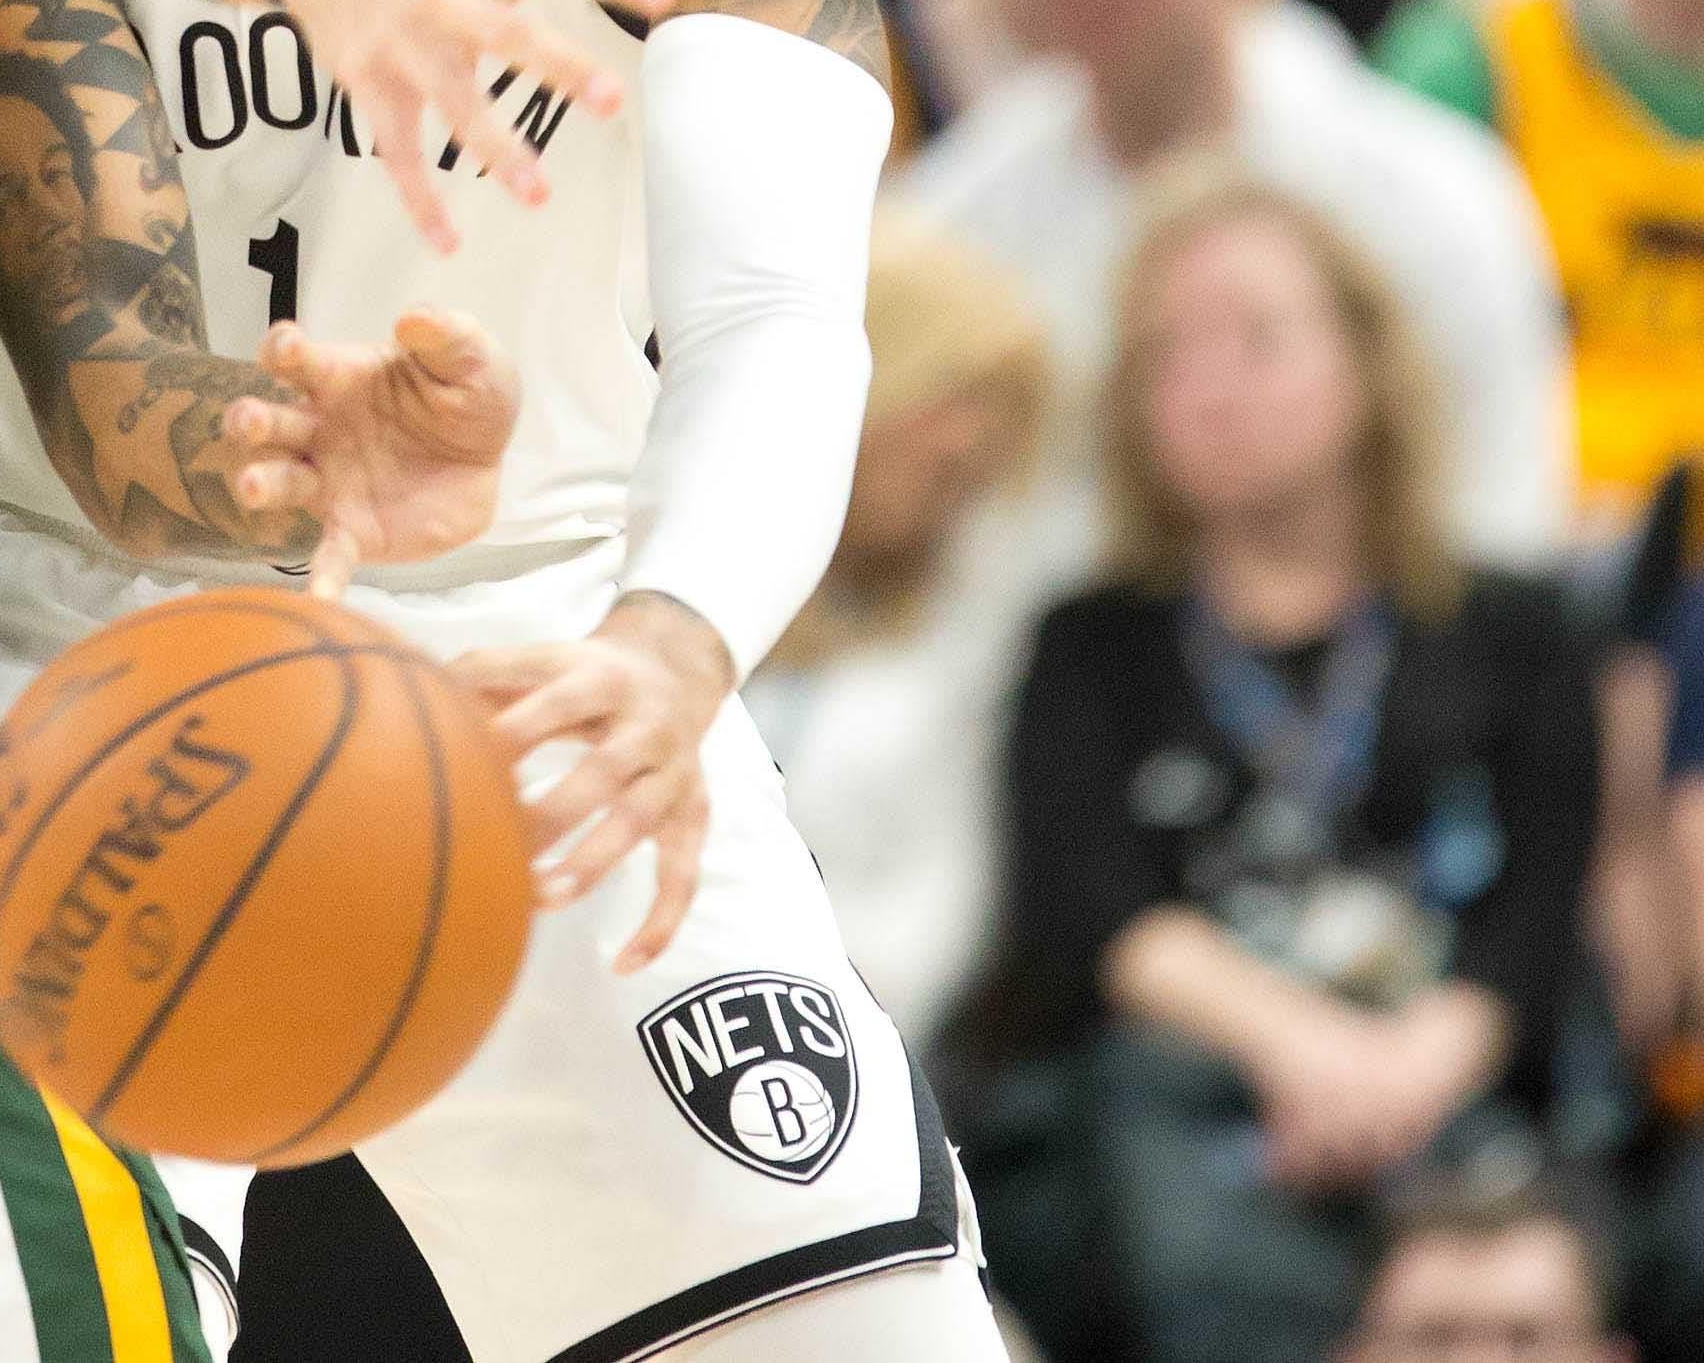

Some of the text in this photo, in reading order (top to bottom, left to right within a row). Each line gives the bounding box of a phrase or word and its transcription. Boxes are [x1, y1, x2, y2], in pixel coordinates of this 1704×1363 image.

[248, 217, 299, 329] 1
[661, 983, 846, 1095] NETS
[760, 1076, 807, 1148] B
